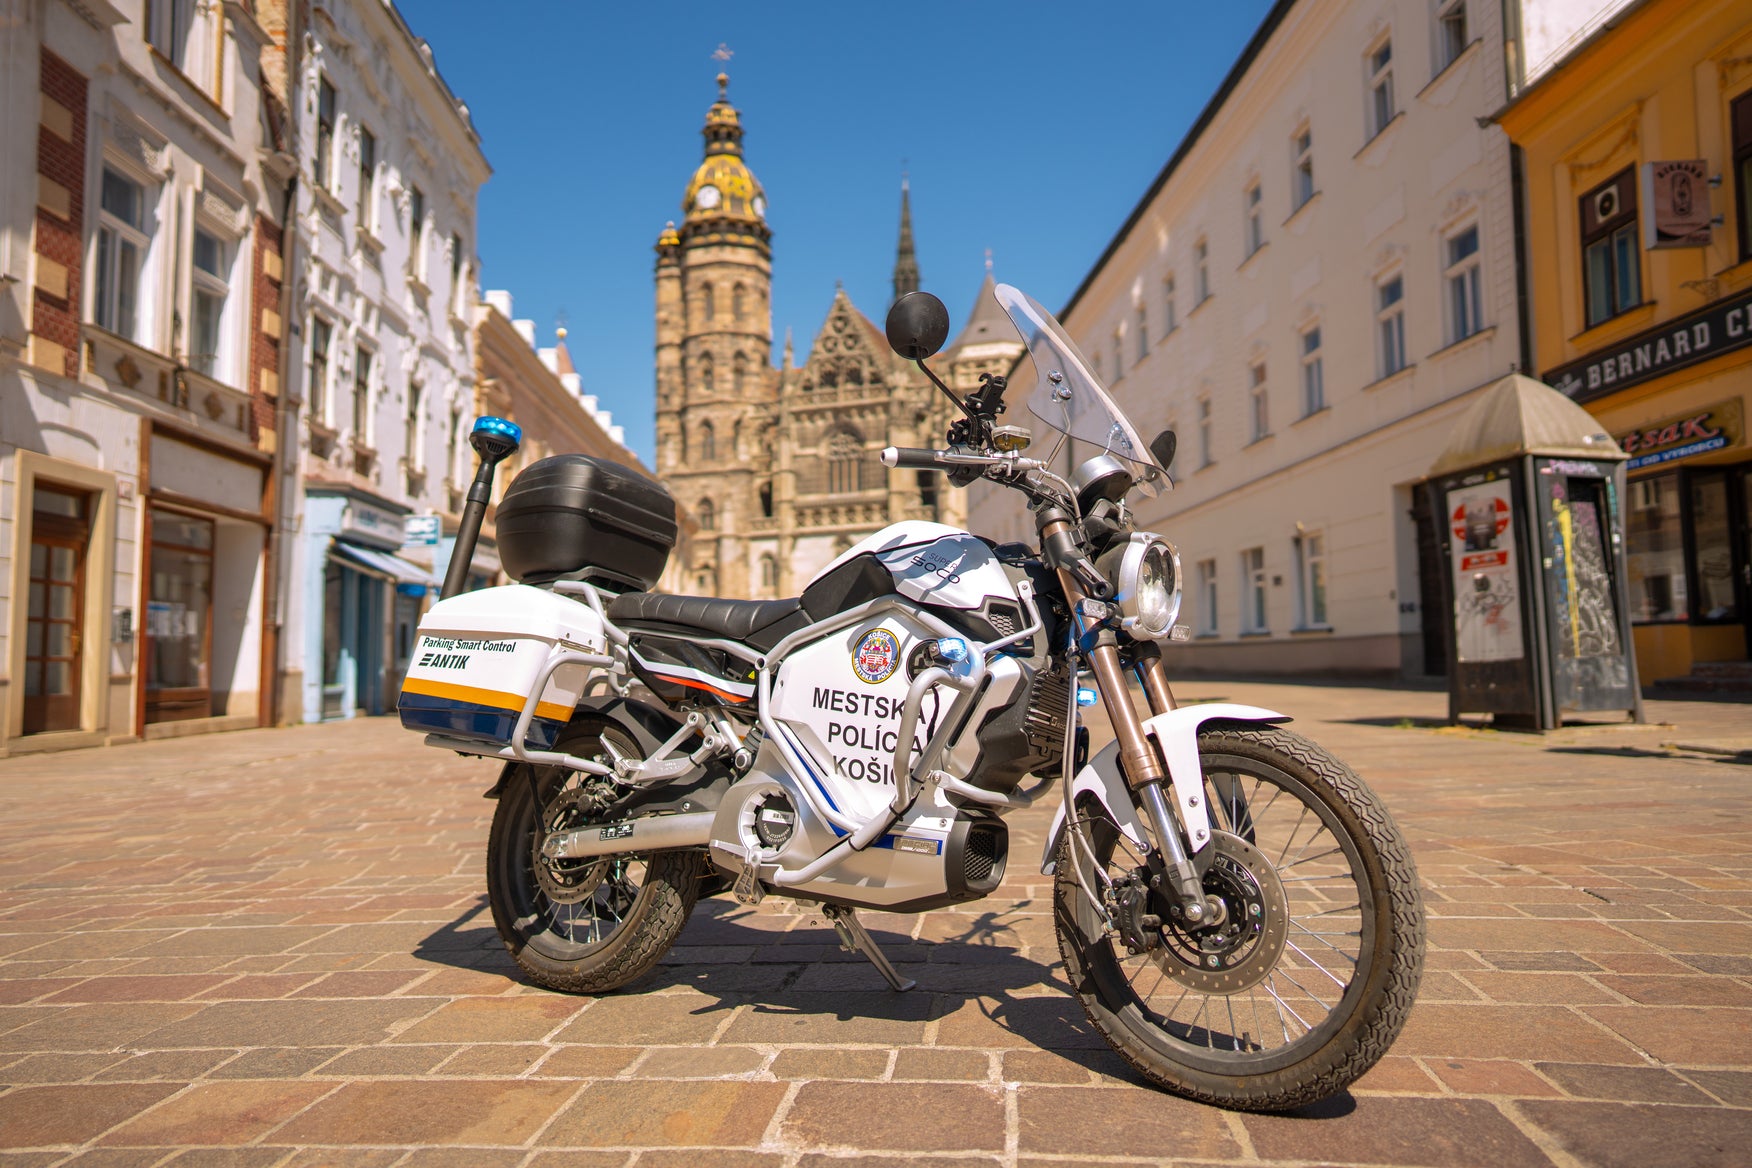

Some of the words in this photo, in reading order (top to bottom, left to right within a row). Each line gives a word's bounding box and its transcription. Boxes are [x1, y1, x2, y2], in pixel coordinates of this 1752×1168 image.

[1586, 321, 1710, 391] BERNARD
[911, 555, 961, 584] SOCO
[422, 637, 455, 651] Parking
[455, 639, 482, 651] Smart
[482, 640, 517, 653] Control
[827, 721, 924, 758] POLÍCA
[833, 755, 906, 786] KOŠI
